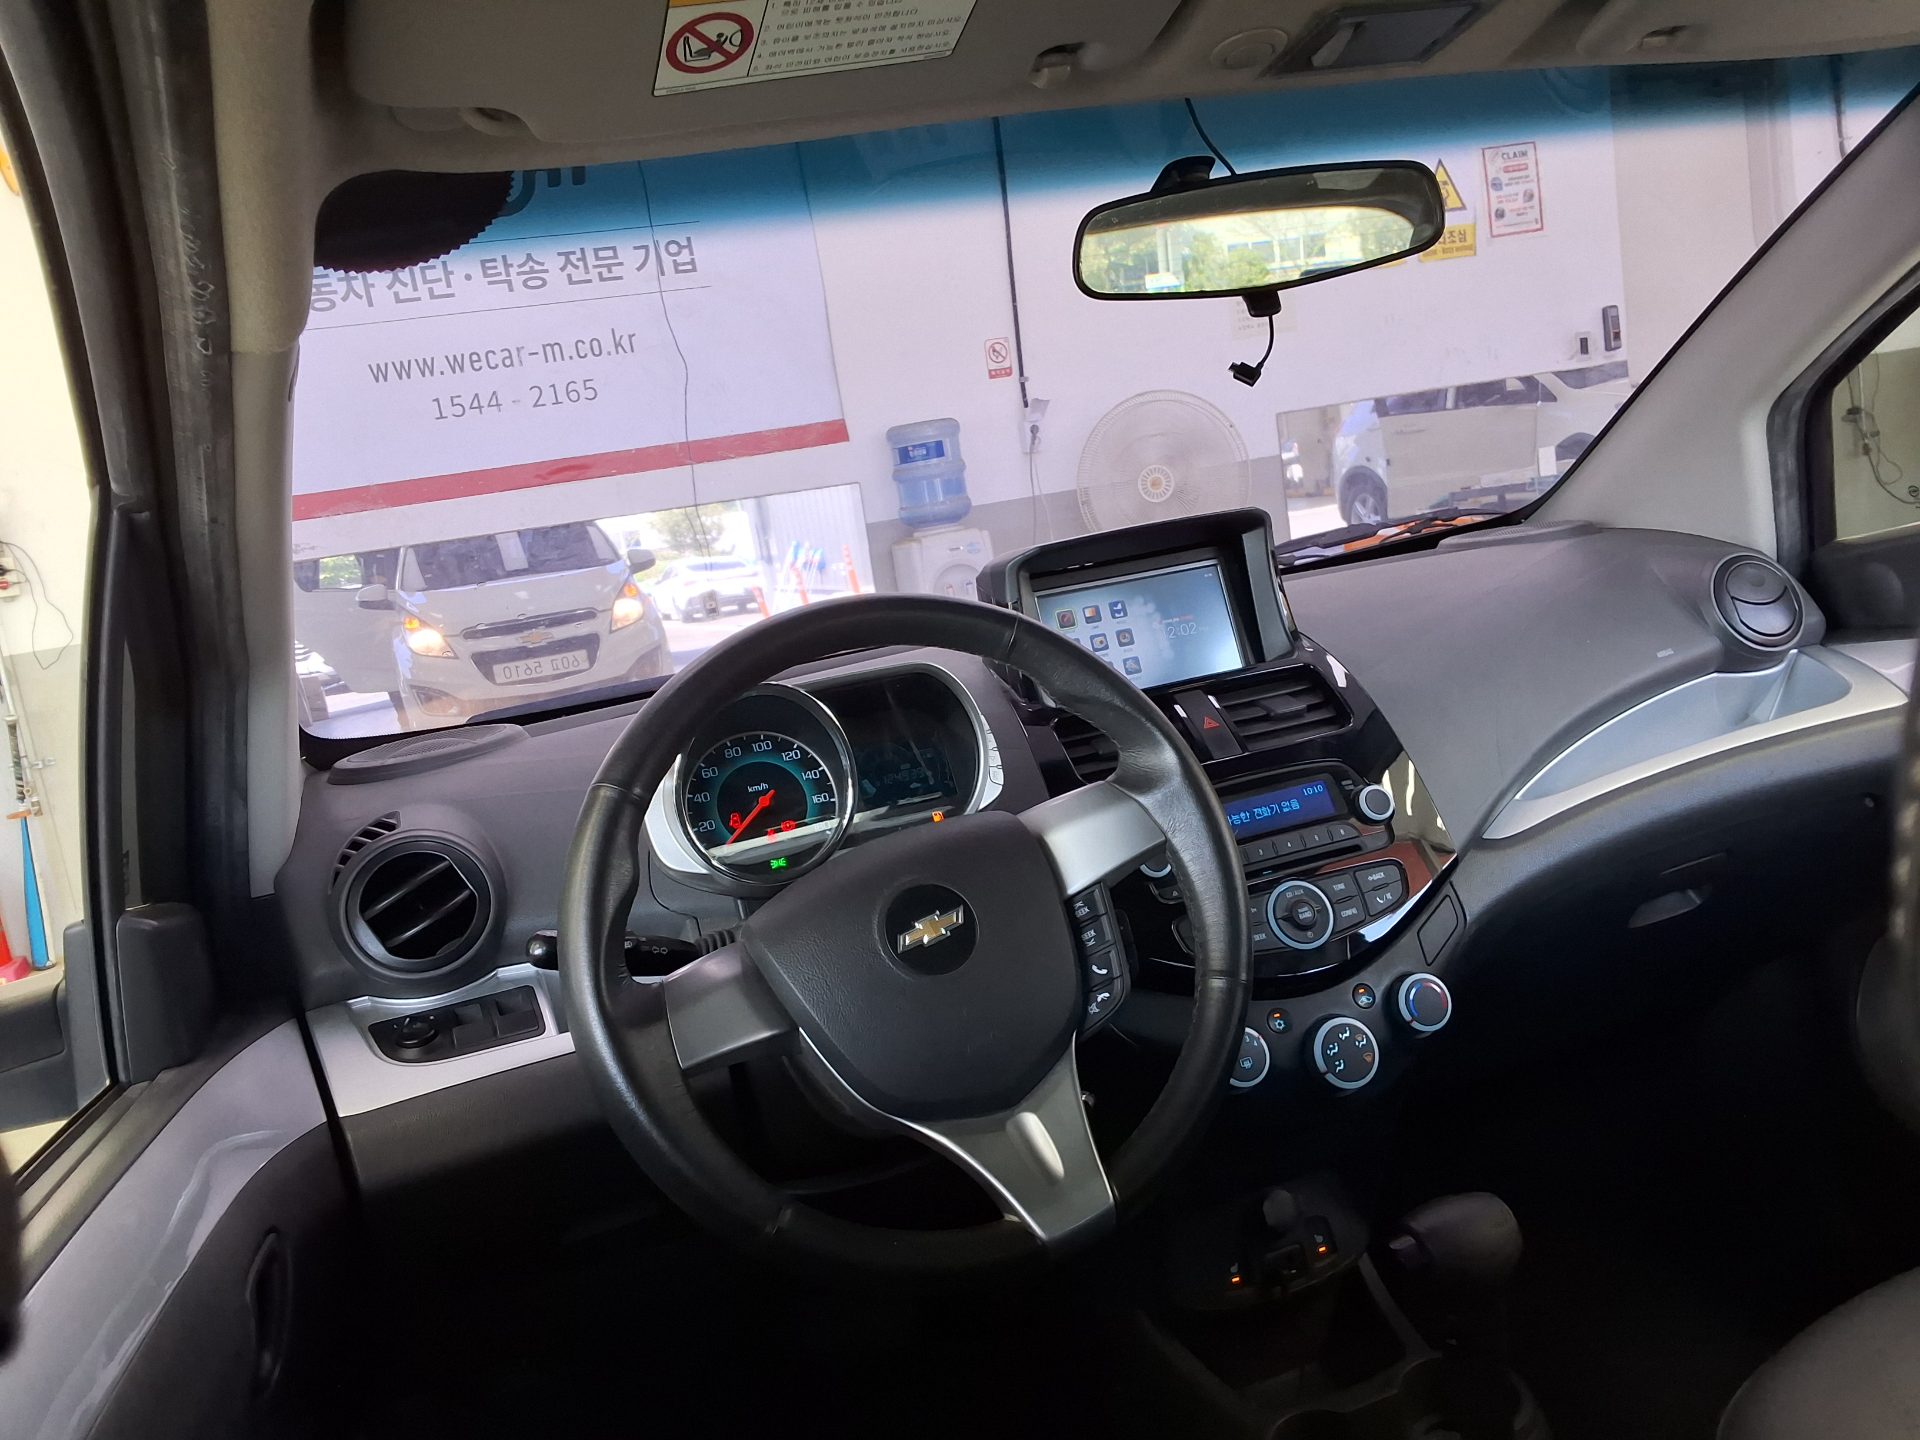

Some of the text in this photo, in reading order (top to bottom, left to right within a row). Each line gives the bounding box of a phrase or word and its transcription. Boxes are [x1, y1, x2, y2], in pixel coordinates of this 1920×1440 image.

[556, 245, 625, 288] 전문
[632, 236, 699, 277] 기업
[368, 329, 637, 385] www.wecar-m.co.kr
[432, 390, 503, 421] 1544
[529, 378, 600, 409] 2165
[724, 746, 742, 759] 80
[752, 739, 773, 753] 100
[781, 749, 801, 762] 120
[701, 766, 719, 779] 60
[801, 768, 820, 781] 140
[747, 782, 769, 793] km/h
[693, 791, 711, 804] 40
[811, 793, 829, 804] 160
[698, 820, 716, 832] 20
